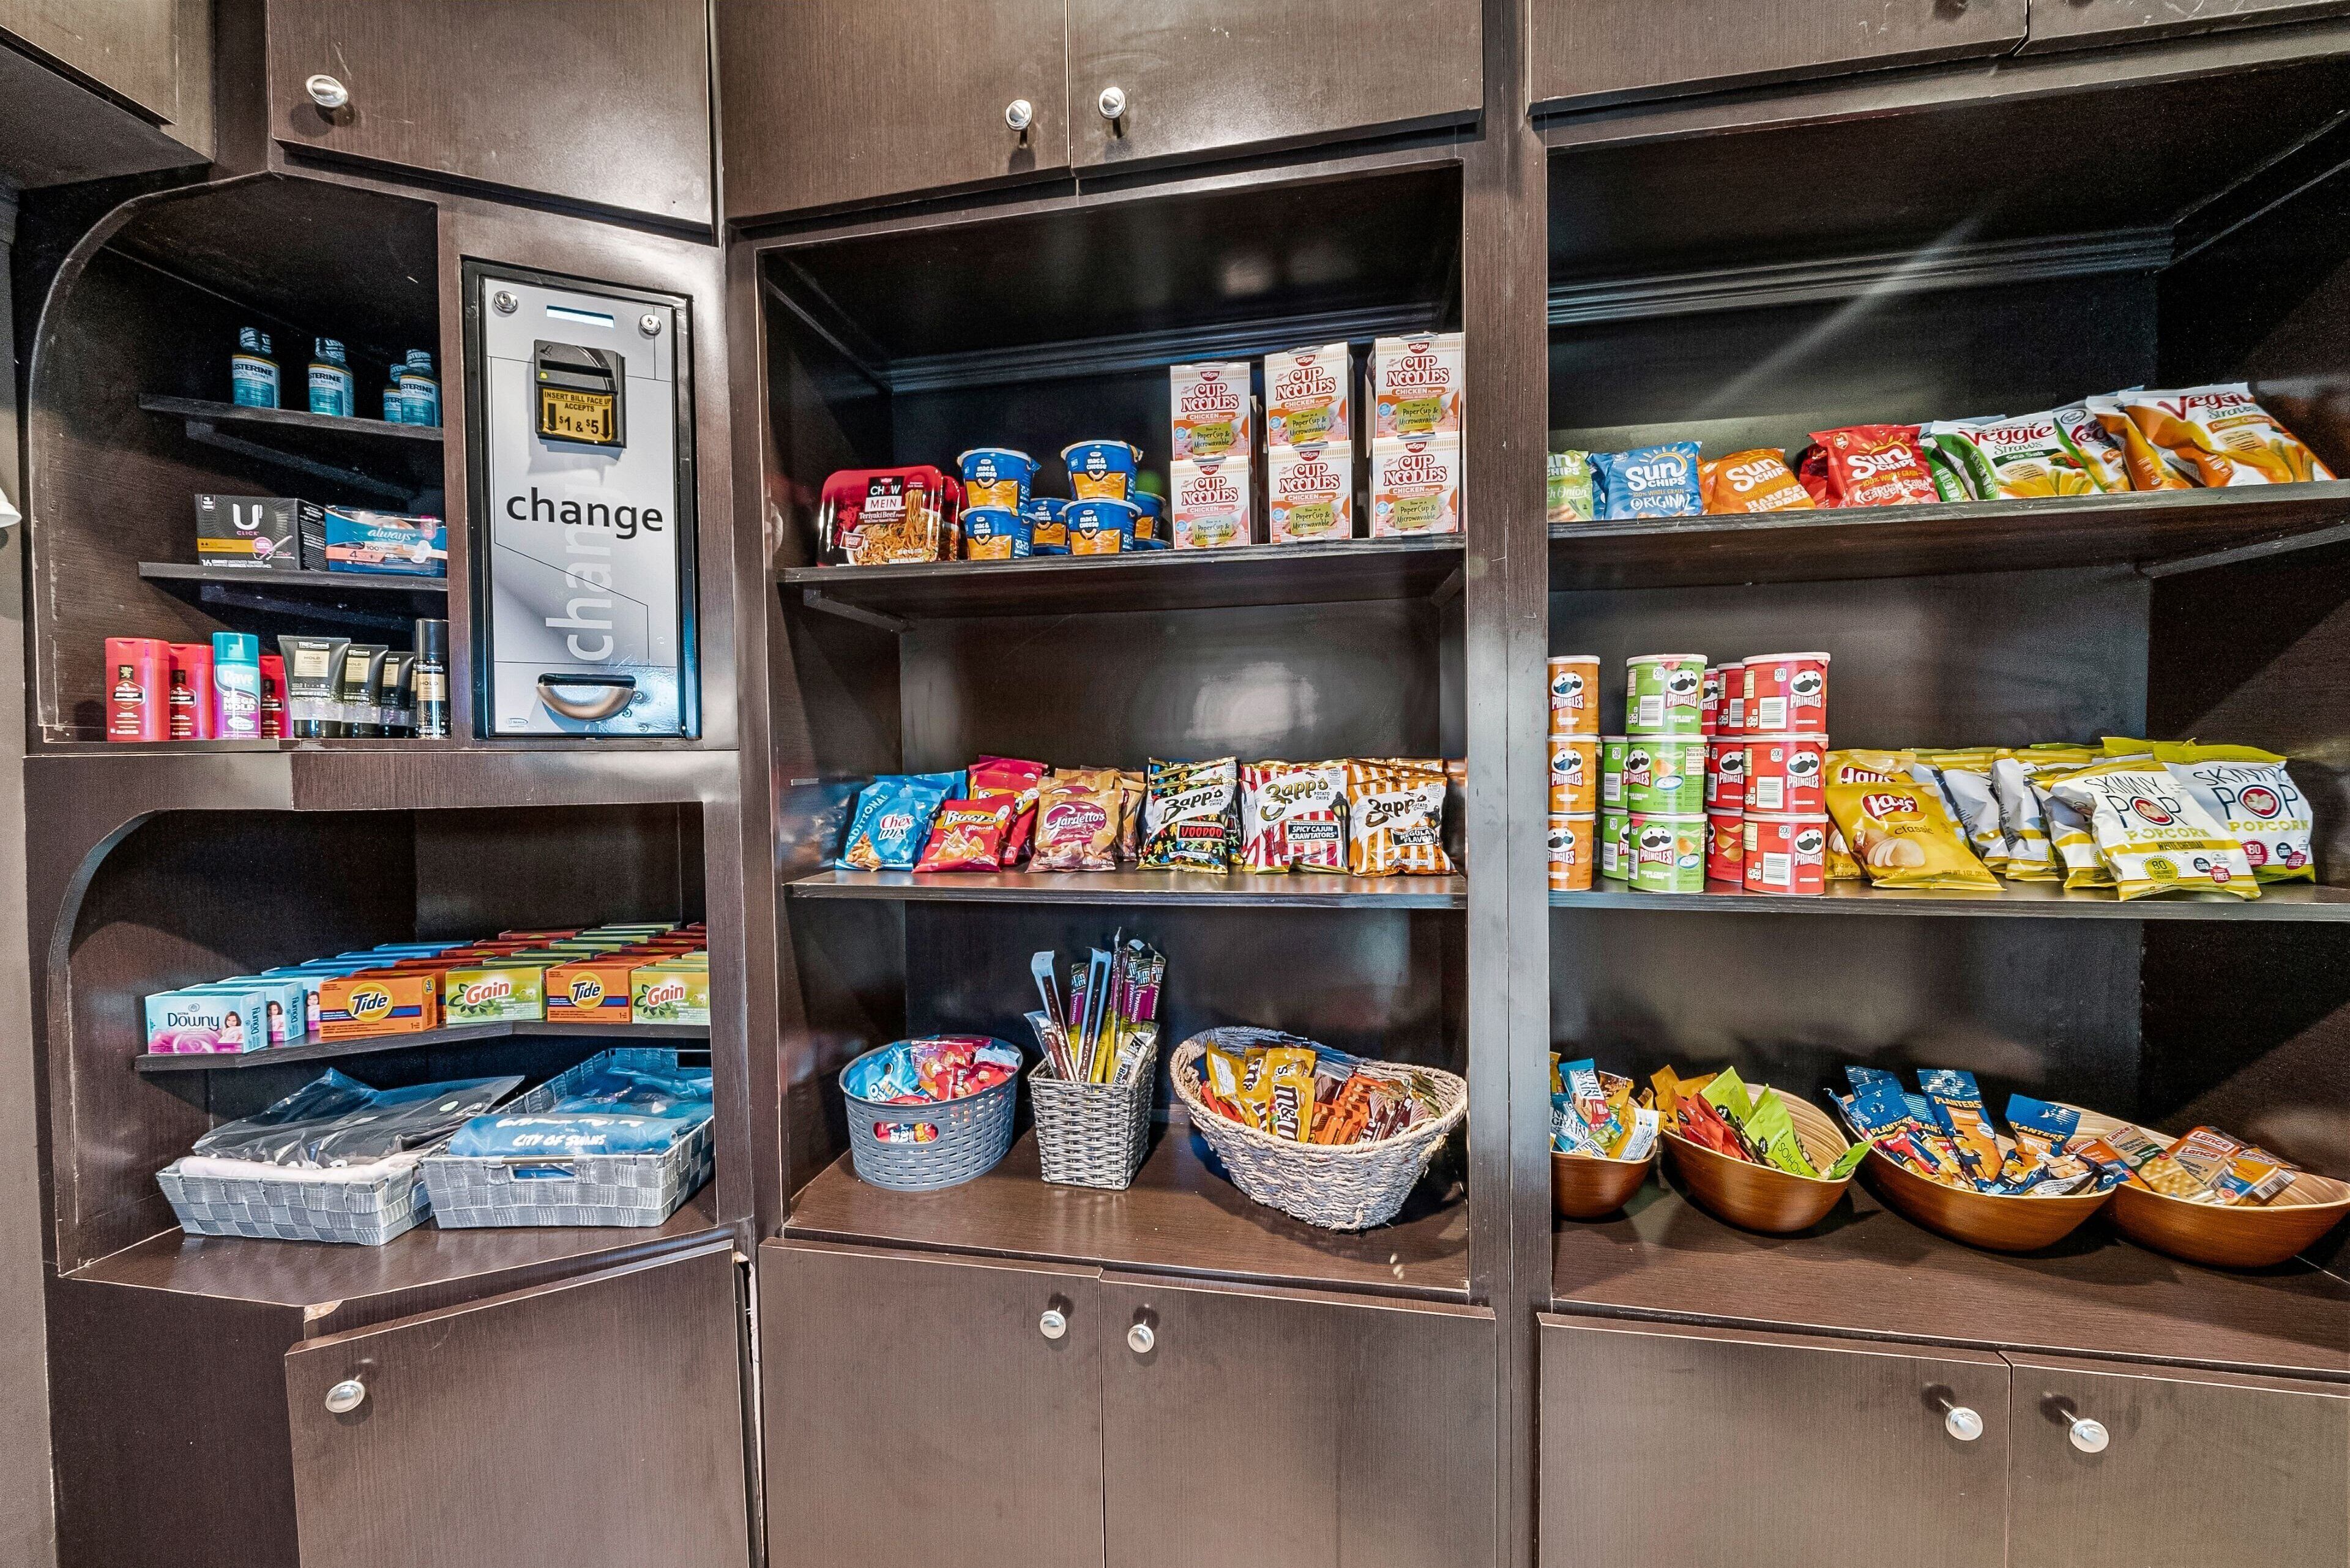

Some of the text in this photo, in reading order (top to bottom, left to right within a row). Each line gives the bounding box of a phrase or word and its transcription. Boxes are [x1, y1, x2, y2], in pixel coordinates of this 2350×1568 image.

[233, 364, 273, 376] STERINE
[1401, 356, 1437, 371] CUP
[309, 373, 341, 383] STERINE
[1289, 367, 1323, 384] CUP
[1386, 368, 1449, 387] NOODLES
[401, 384, 433, 394] STERINE
[545, 391, 568, 400] INSERT
[1195, 383, 1228, 397] CUP
[1276, 377, 1336, 400] NOODLES
[565, 403, 594, 412] ACCEPTS
[1181, 394, 1239, 412] NOODLES
[559, 416, 599, 434] $1 & $5
[1398, 416, 1437, 427] Microwavable
[1289, 426, 1326, 438] Microwavable
[1958, 424, 2057, 446] Veggie
[1194, 439, 1229, 449] Microwavable
[1994, 441, 2043, 455] Straws
[1293, 463, 1328, 477] CUP
[1398, 454, 1434, 471] CUP
[1848, 449, 1912, 480] Sun
[1878, 458, 1916, 471] CHIPS
[1384, 466, 1447, 486] NOODLES
[1625, 461, 1687, 491] Sun
[1647, 477, 1686, 487] CHIPS
[1726, 457, 1782, 493] Sun
[870, 485, 901, 495] CHOW
[1194, 476, 1226, 491] CUP
[1279, 474, 1340, 493] NOODLES
[870, 499, 897, 509] MEIN
[1182, 487, 1238, 506] NOODLES
[1630, 495, 1695, 510] ORIGINAL
[233, 504, 260, 530] U
[506, 487, 663, 539] change
[1397, 513, 1435, 524] Microwavable
[1292, 520, 1329, 530] Microwavable
[368, 528, 412, 542] always
[1195, 531, 1229, 541] Microwavable
[1552, 695, 1583, 710] PRINGLES
[1665, 691, 1698, 707] PRINGLES
[1790, 694, 1822, 709] PRINGLES
[1551, 772, 1583, 786] PRINGLES
[1786, 774, 1819, 788] PRINGLES
[2084, 773, 2164, 795] SKINNY
[1161, 788, 1224, 824] Zapp's
[1260, 777, 1329, 822] Zapp's
[1868, 794, 1915, 817] Lay's
[2212, 784, 2299, 819] POP
[2106, 795, 2188, 829] POP
[881, 814, 913, 828] Chex
[1044, 804, 1106, 839] Gardetto's
[2228, 819, 2310, 832] POPCORN
[1181, 826, 1223, 838] VOODOO
[1895, 824, 1934, 835] Classic
[2125, 827, 2209, 841] POPCORN
[1639, 848, 1674, 865] PRINGLES
[2248, 845, 2261, 854] 80
[1794, 851, 1822, 866] PRINGLES
[2152, 860, 2167, 870] 80
[466, 982, 509, 1004] Gain
[572, 982, 600, 1002] Tide
[647, 985, 684, 1005] Gain
[352, 993, 388, 1015] Tide
[1132, 993, 1141, 1023] ORIGINAL
[168, 1013, 220, 1031] Downy
[1933, 1096, 1982, 1108] PLANTERS
[513, 1134, 544, 1146] CITY
[543, 1134, 565, 1146] OF
[2106, 1126, 2130, 1142] Lance
[2193, 1132, 2229, 1148] Lance
[2115, 1136, 2145, 1149] Captain's
[2182, 1147, 2218, 1158] Lance
